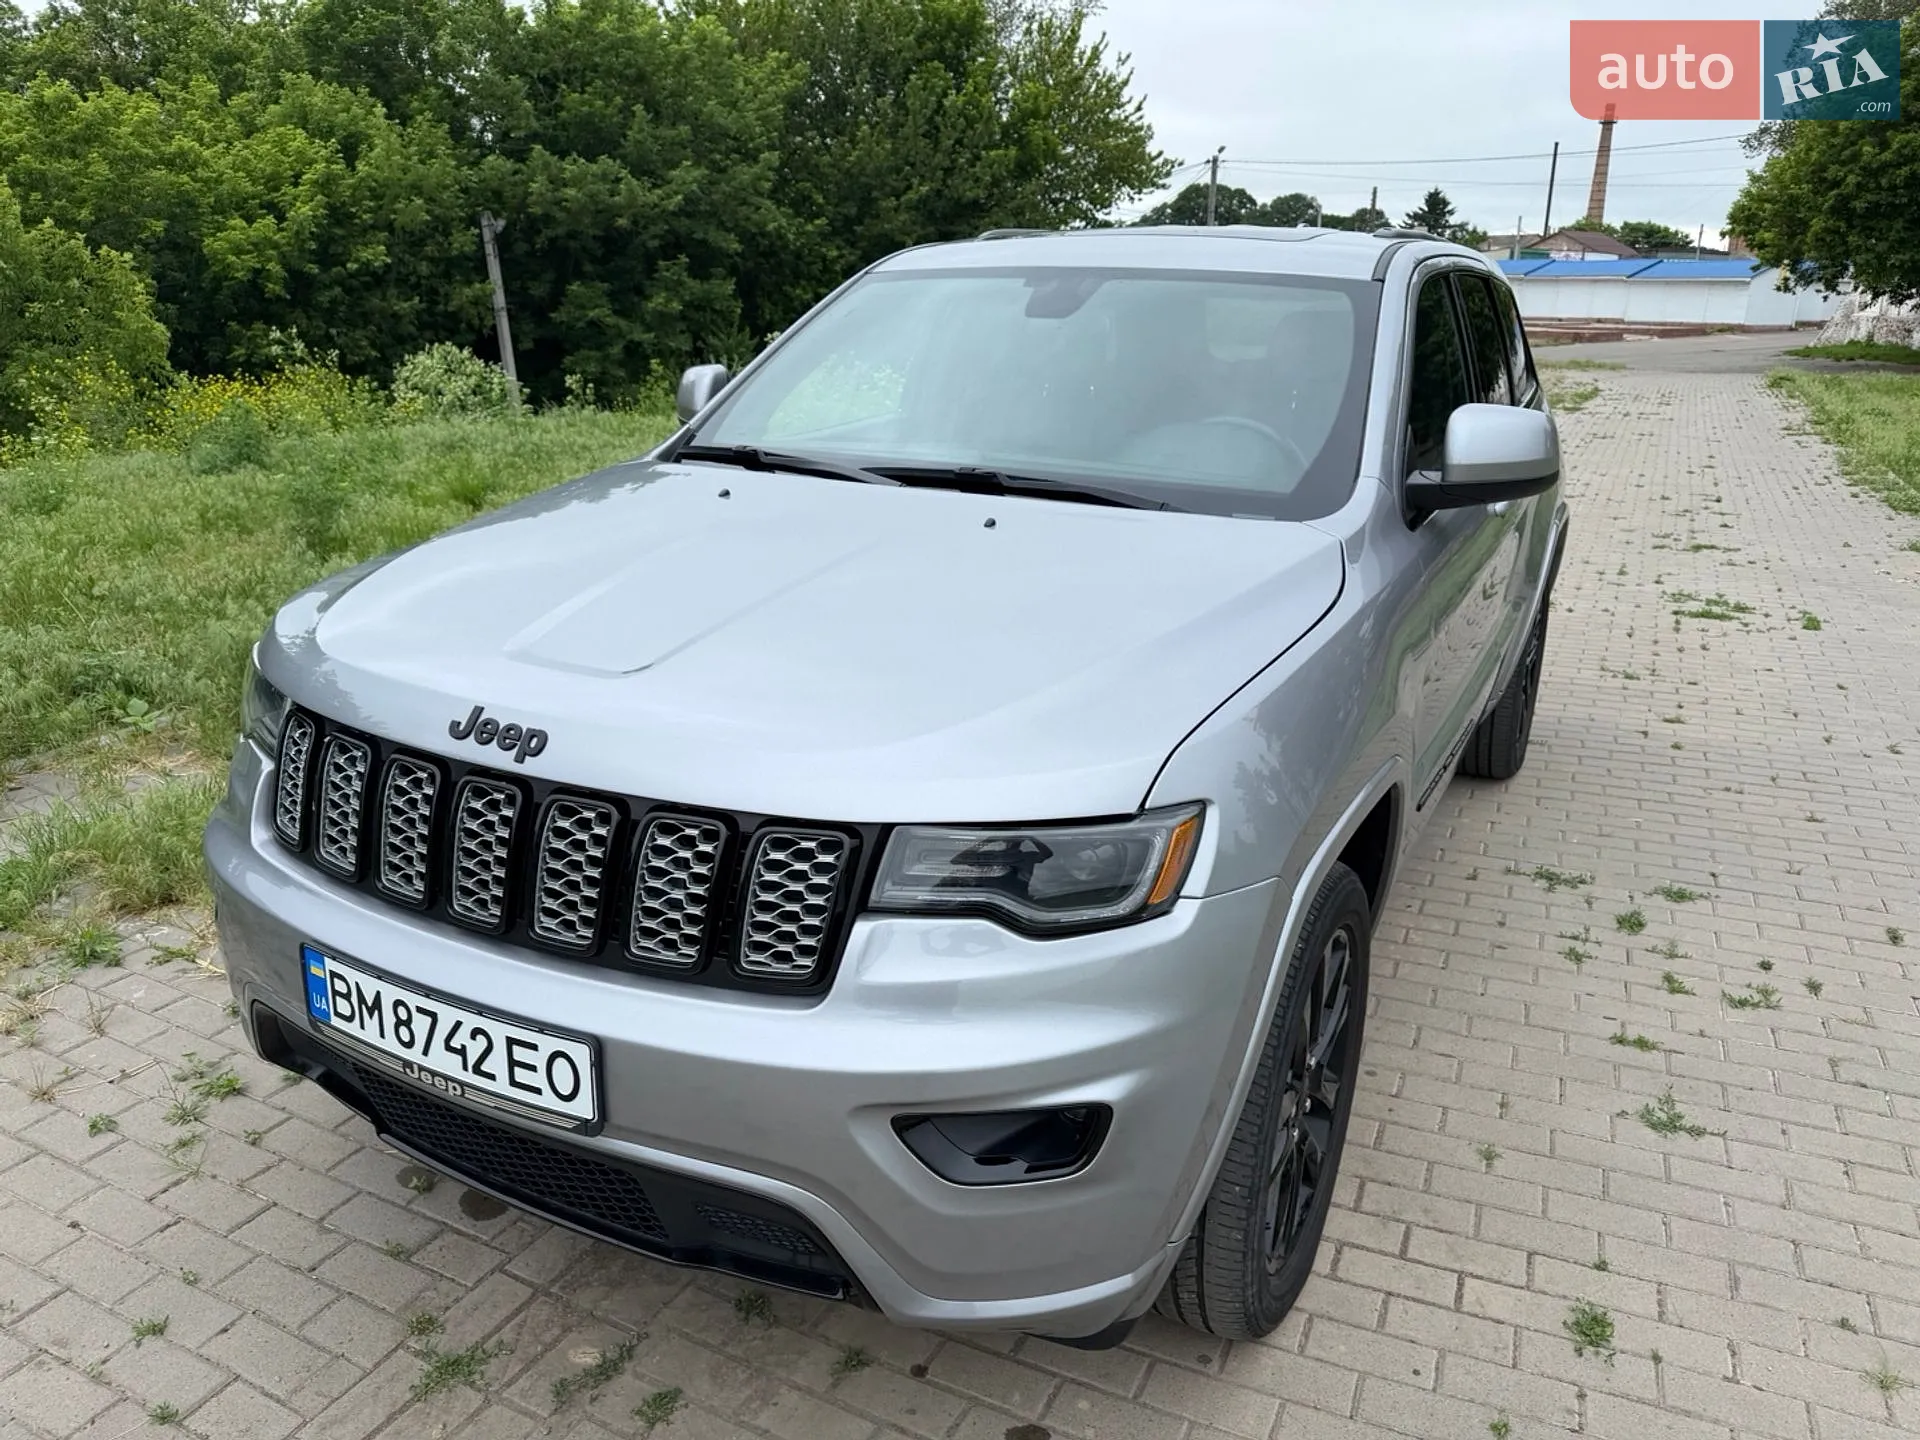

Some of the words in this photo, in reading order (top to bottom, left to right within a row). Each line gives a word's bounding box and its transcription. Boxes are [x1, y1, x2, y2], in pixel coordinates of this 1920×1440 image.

[449, 705, 548, 764] Jeep
[313, 992, 329, 1012] UA
[405, 1063, 462, 1097] Jeep
